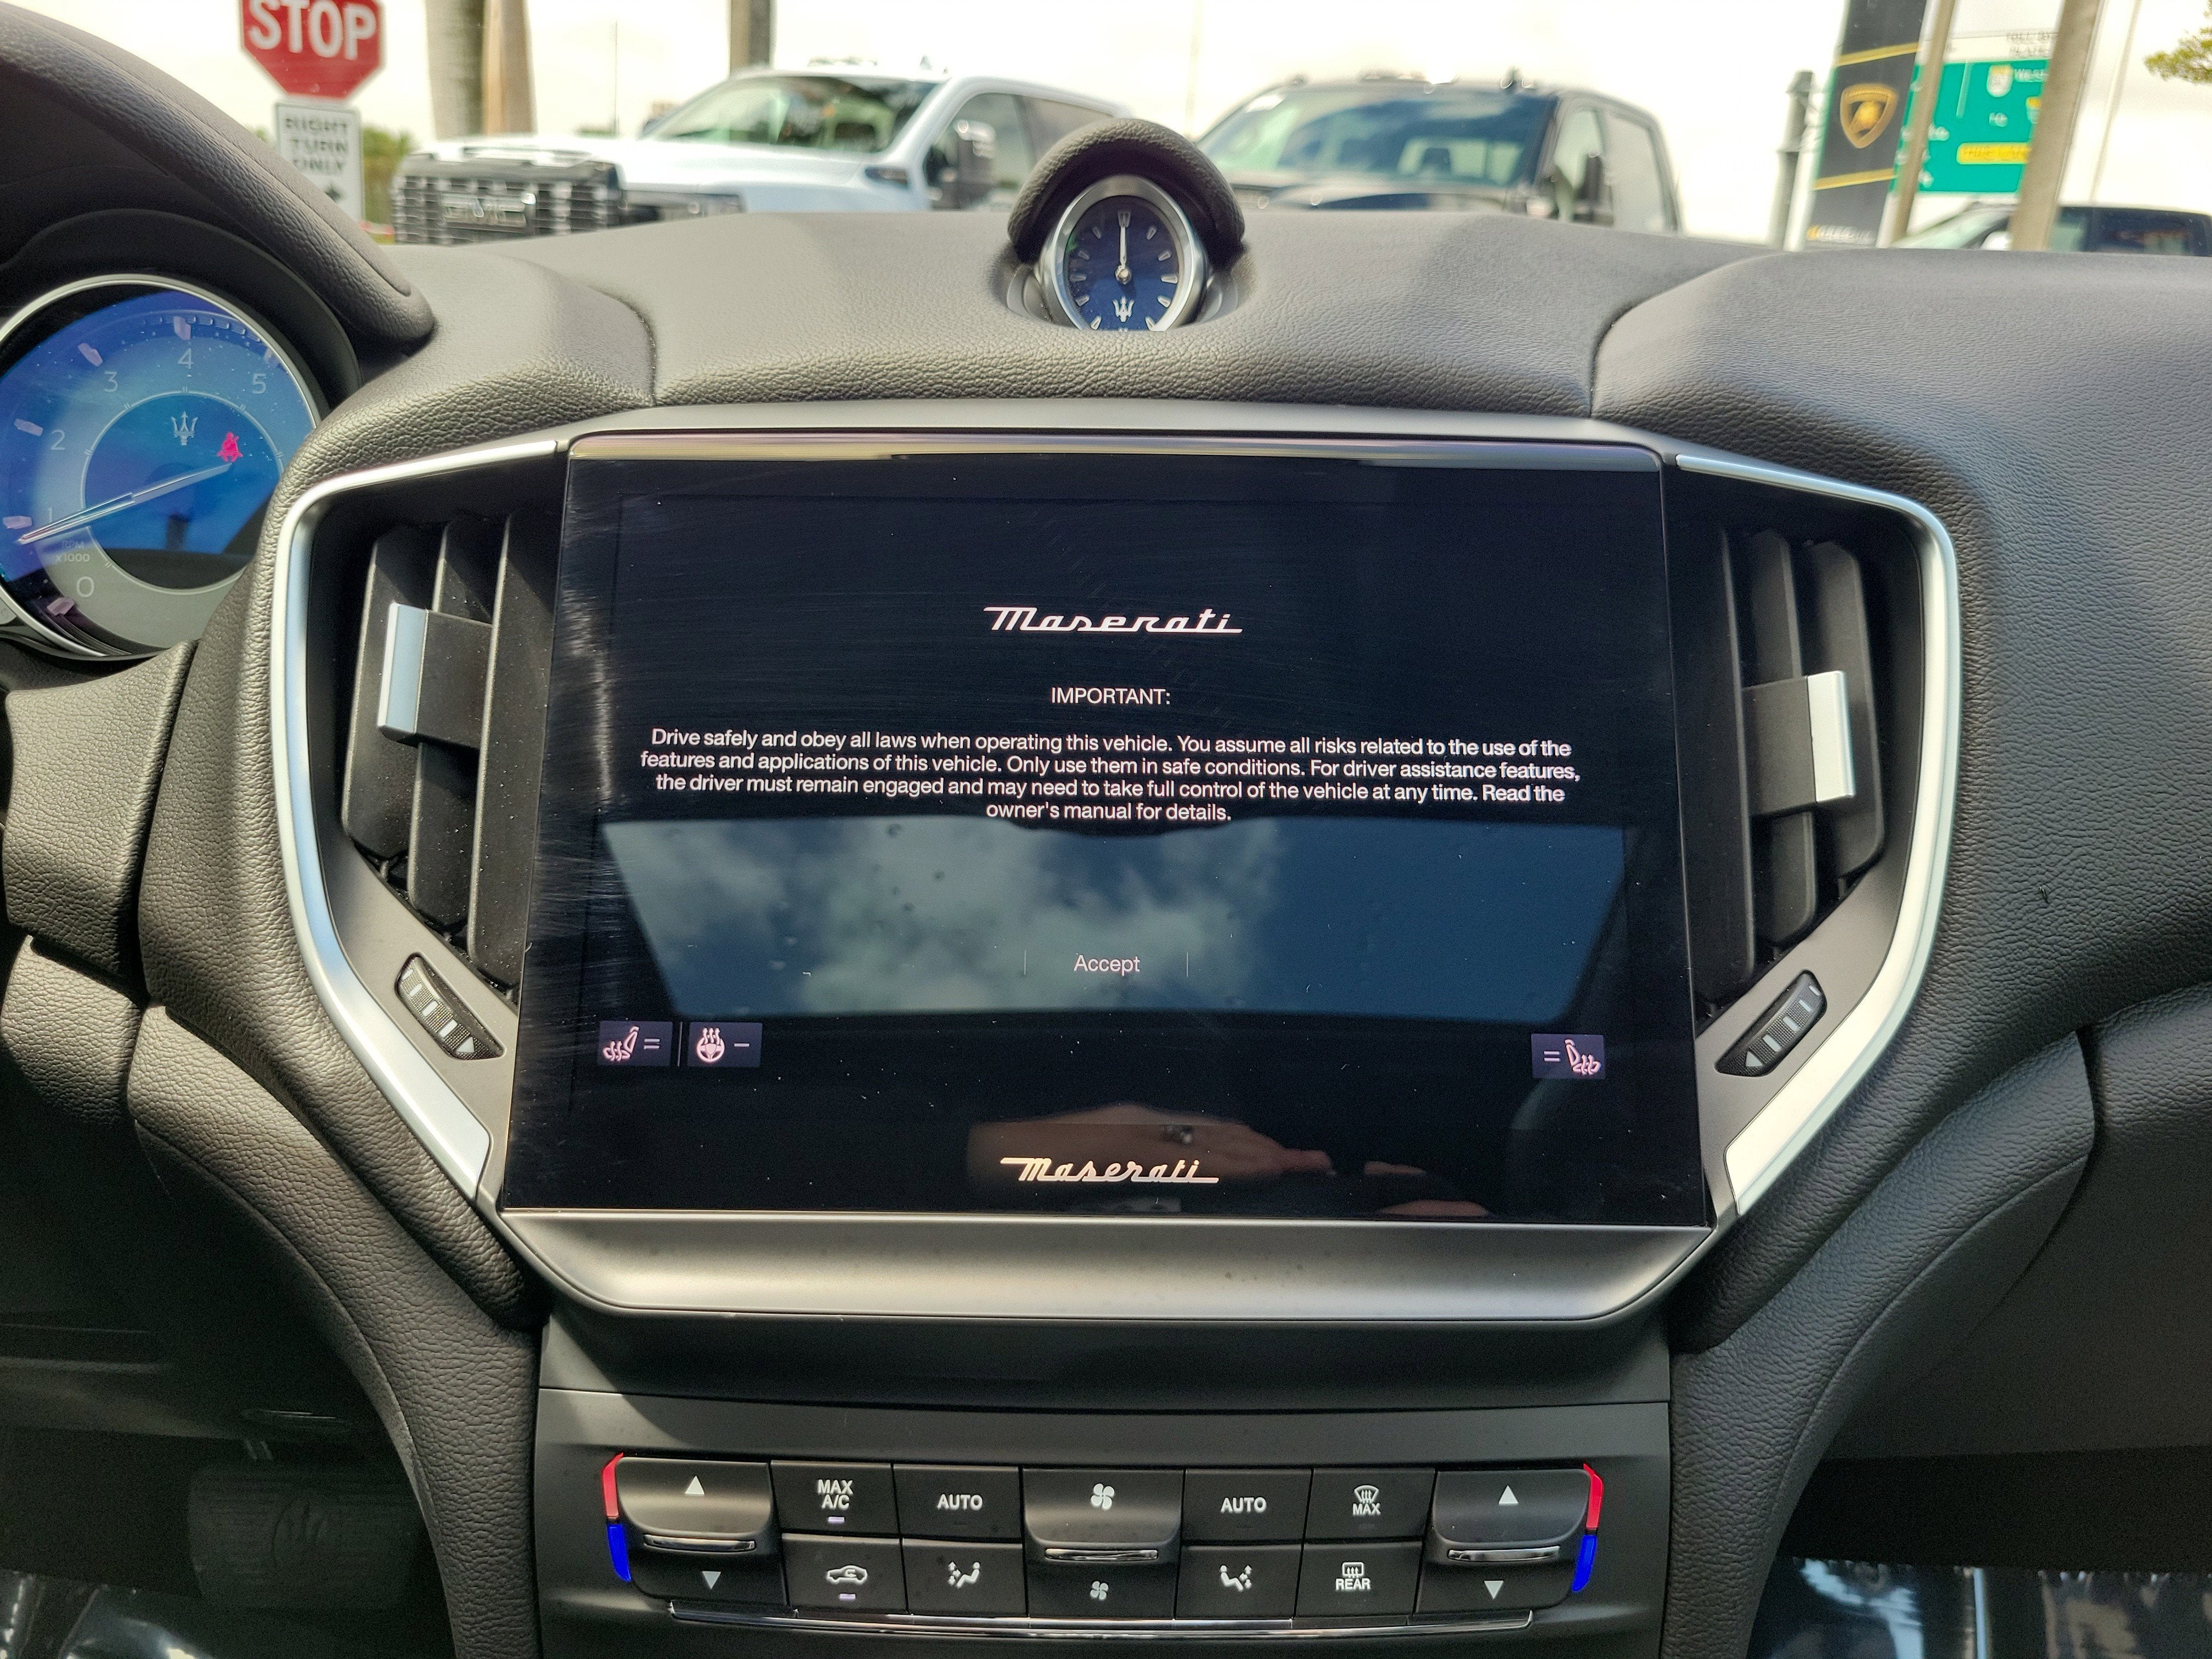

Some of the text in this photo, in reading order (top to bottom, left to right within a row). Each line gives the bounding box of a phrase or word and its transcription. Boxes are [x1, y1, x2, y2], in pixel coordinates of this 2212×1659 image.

[249, 0, 376, 60] STOP
[285, 116, 348, 133] RIGHT
[292, 137, 348, 153] TURN
[178, 348, 194, 369] 4
[104, 371, 119, 393] 3
[252, 373, 267, 394] 5
[51, 429, 66, 451] 2
[76, 576, 95, 598] 0
[984, 606, 1243, 633] Maserati
[1052, 687, 1170, 704] IMPORTANT:
[652, 728, 1572, 757] Drive safely and obey all laws when operating this vehicle. You assume all risks related to the use of the
[640, 751, 1580, 782] features and applications of this vehicle. Only use them in safe conditions. For driver assistance features,
[656, 773, 1565, 804] the driver must remain engaged and may need to take full control of the vehicle at any time. Read the
[986, 801, 1231, 820] owner's manual for details.
[1074, 955, 1141, 977] Accept
[1000, 1157, 1220, 1184] Maserati
[817, 1479, 854, 1496] MAX
[821, 1493, 850, 1510] A/C
[937, 1494, 983, 1511] AUTO
[1220, 1497, 1267, 1514] AUTO
[1352, 1502, 1381, 1516] MAX
[1335, 1577, 1371, 1592] REAR
